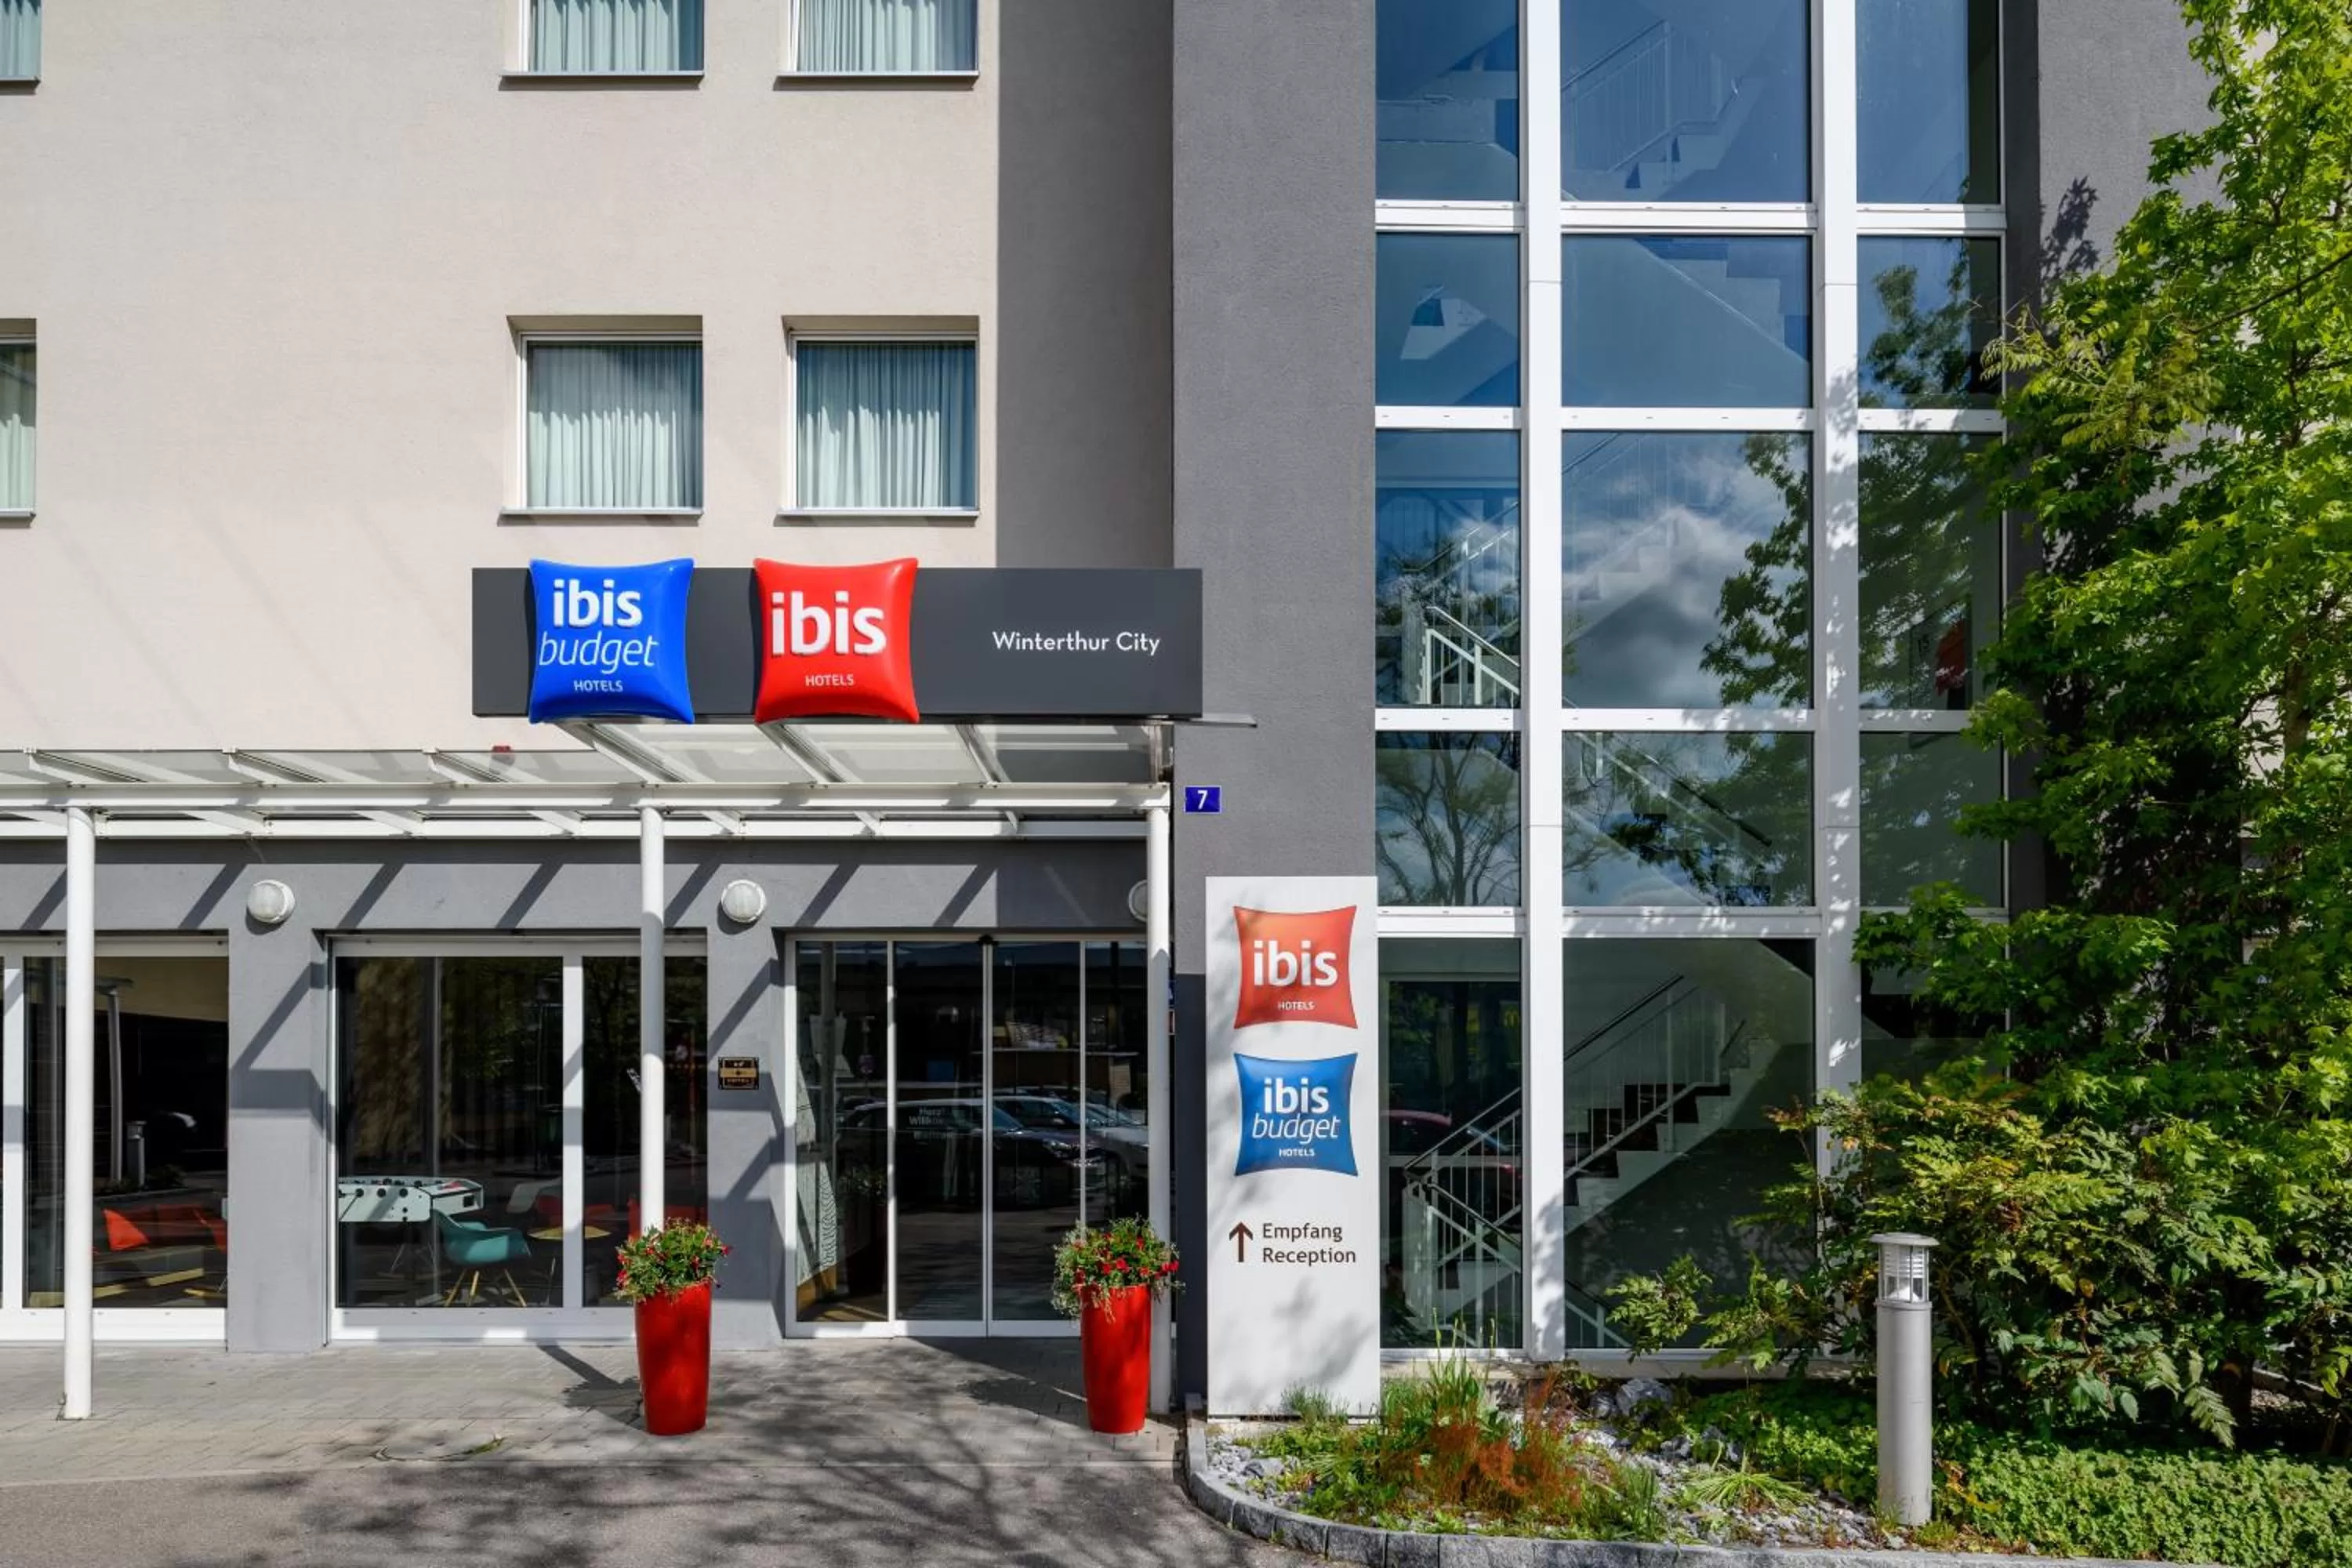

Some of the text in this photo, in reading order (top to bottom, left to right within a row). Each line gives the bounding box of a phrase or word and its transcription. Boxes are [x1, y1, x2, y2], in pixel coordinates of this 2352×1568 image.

[553, 579, 643, 627] ibis
[771, 590, 887, 655] ibis
[539, 630, 658, 674] budget
[992, 630, 1160, 656] Winterthur City
[573, 679, 622, 692] HOTELS
[804, 673, 854, 687] HOTELS
[1196, 789, 1208, 810] 7
[1254, 939, 1338, 986] ibis
[1277, 1000, 1316, 1011] HOTELS
[1264, 1077, 1330, 1114] ibis
[1252, 1112, 1341, 1145] budget
[1278, 1147, 1316, 1158] HOTELS
[1262, 1222, 1343, 1243] Empfang
[1262, 1247, 1356, 1267] Reception
